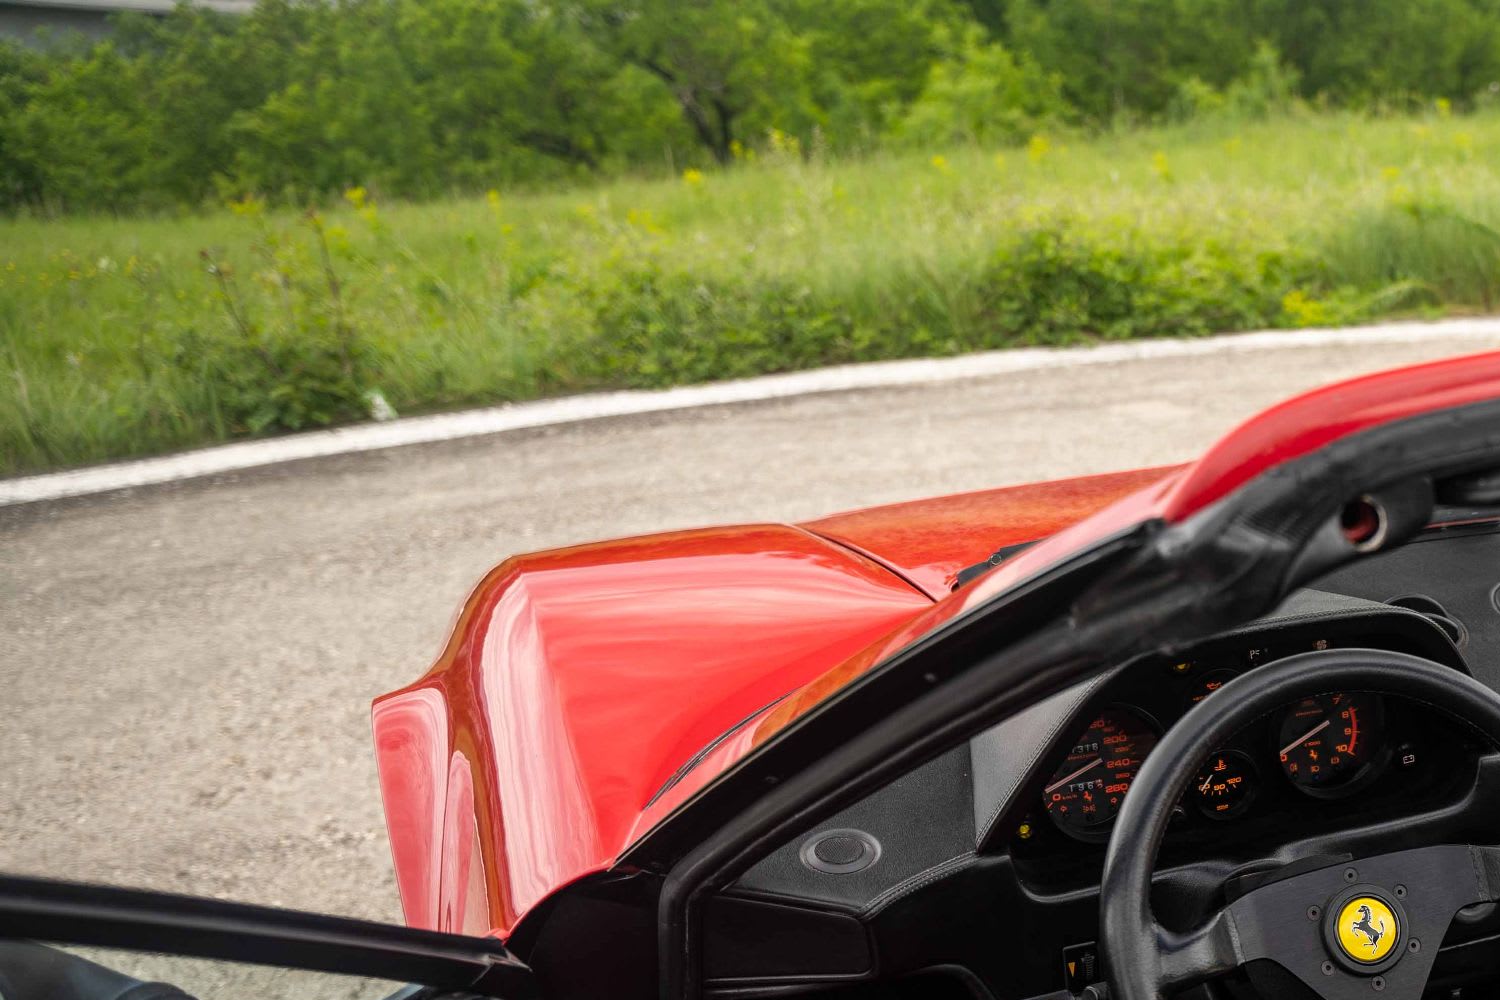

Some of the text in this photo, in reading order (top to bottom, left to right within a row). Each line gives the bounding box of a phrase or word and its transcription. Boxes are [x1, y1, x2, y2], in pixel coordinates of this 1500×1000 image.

[1103, 734, 1128, 745] 200
[1335, 744, 1348, 752] 10
[1106, 758, 1131, 769] 240
[1105, 783, 1129, 794] 280
[1052, 793, 1061, 801] 0
